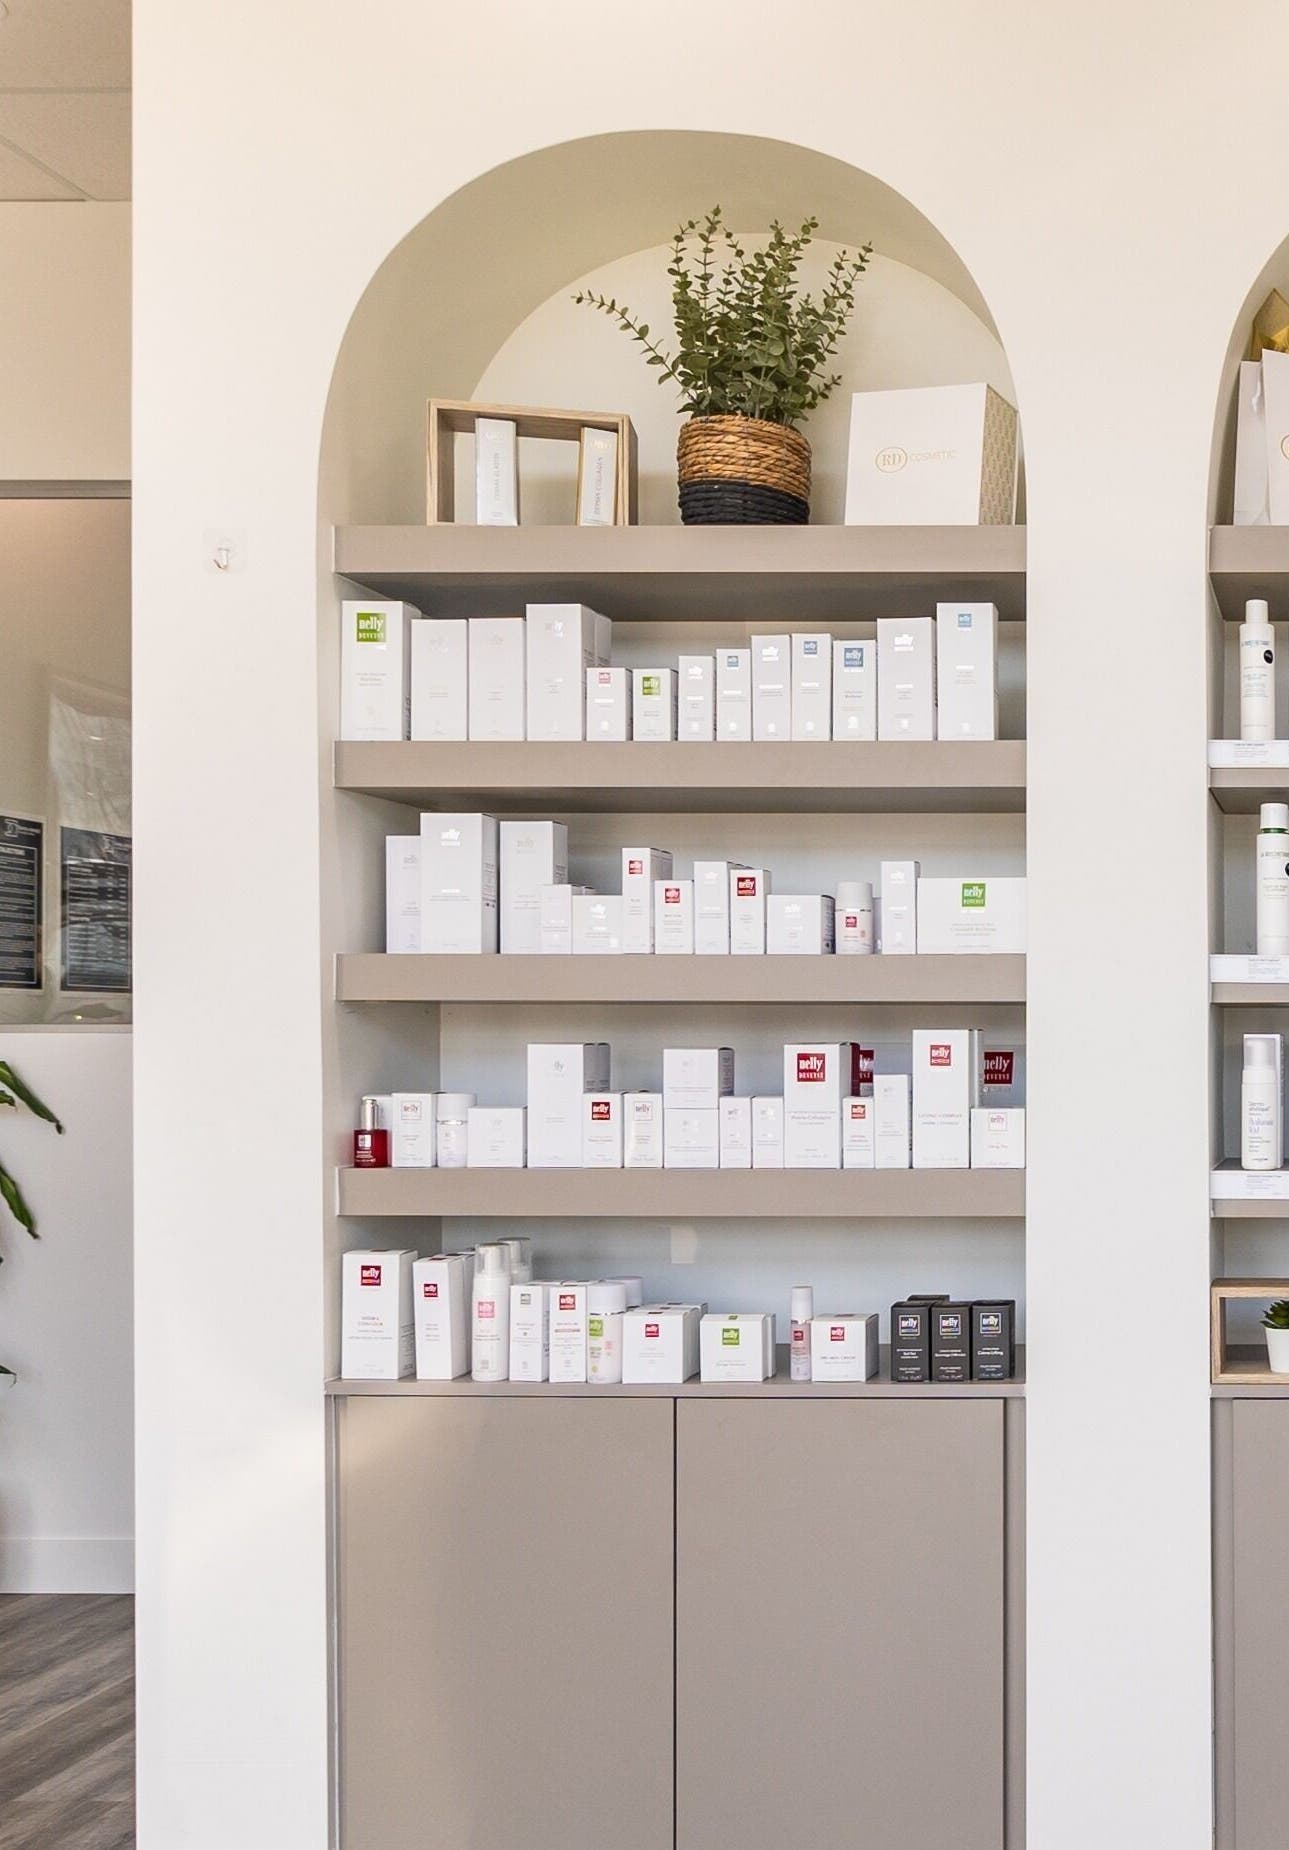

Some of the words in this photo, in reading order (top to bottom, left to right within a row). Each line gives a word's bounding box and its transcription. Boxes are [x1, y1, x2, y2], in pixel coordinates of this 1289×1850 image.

[358, 616, 384, 632] nelly
[931, 1047, 950, 1059] nelly
[799, 1057, 824, 1071] nelly
